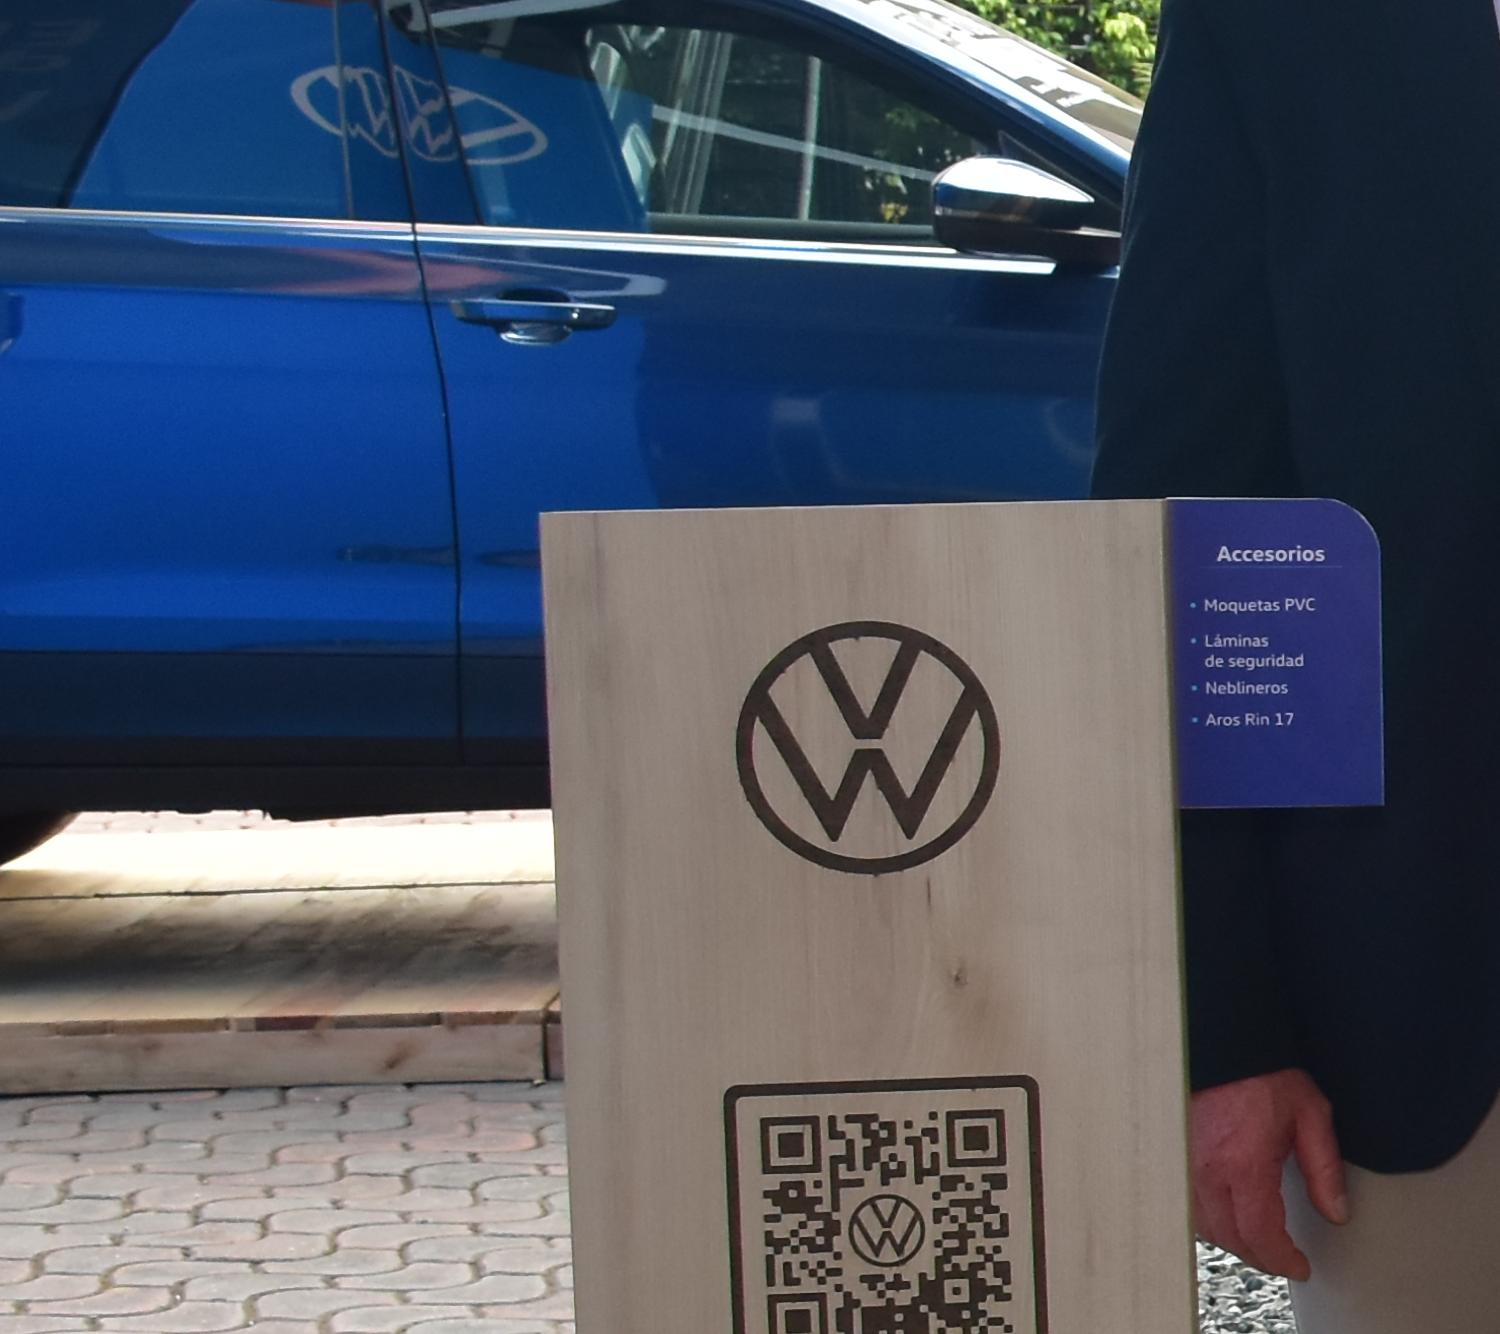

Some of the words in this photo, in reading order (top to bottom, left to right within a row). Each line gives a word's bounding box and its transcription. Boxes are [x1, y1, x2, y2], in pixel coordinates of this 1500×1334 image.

[1217, 546, 1326, 562] Accesorios
[1204, 599, 1280, 614] Moquetas
[1285, 598, 1316, 612] PVC
[1205, 633, 1269, 648] Láminas
[1205, 654, 1224, 668] de
[1228, 654, 1304, 671] seguridad
[1205, 681, 1289, 695] Neblineros
[1206, 713, 1241, 727] Aros
[1245, 712, 1270, 726] Rin
[1275, 712, 1294, 726] 17
